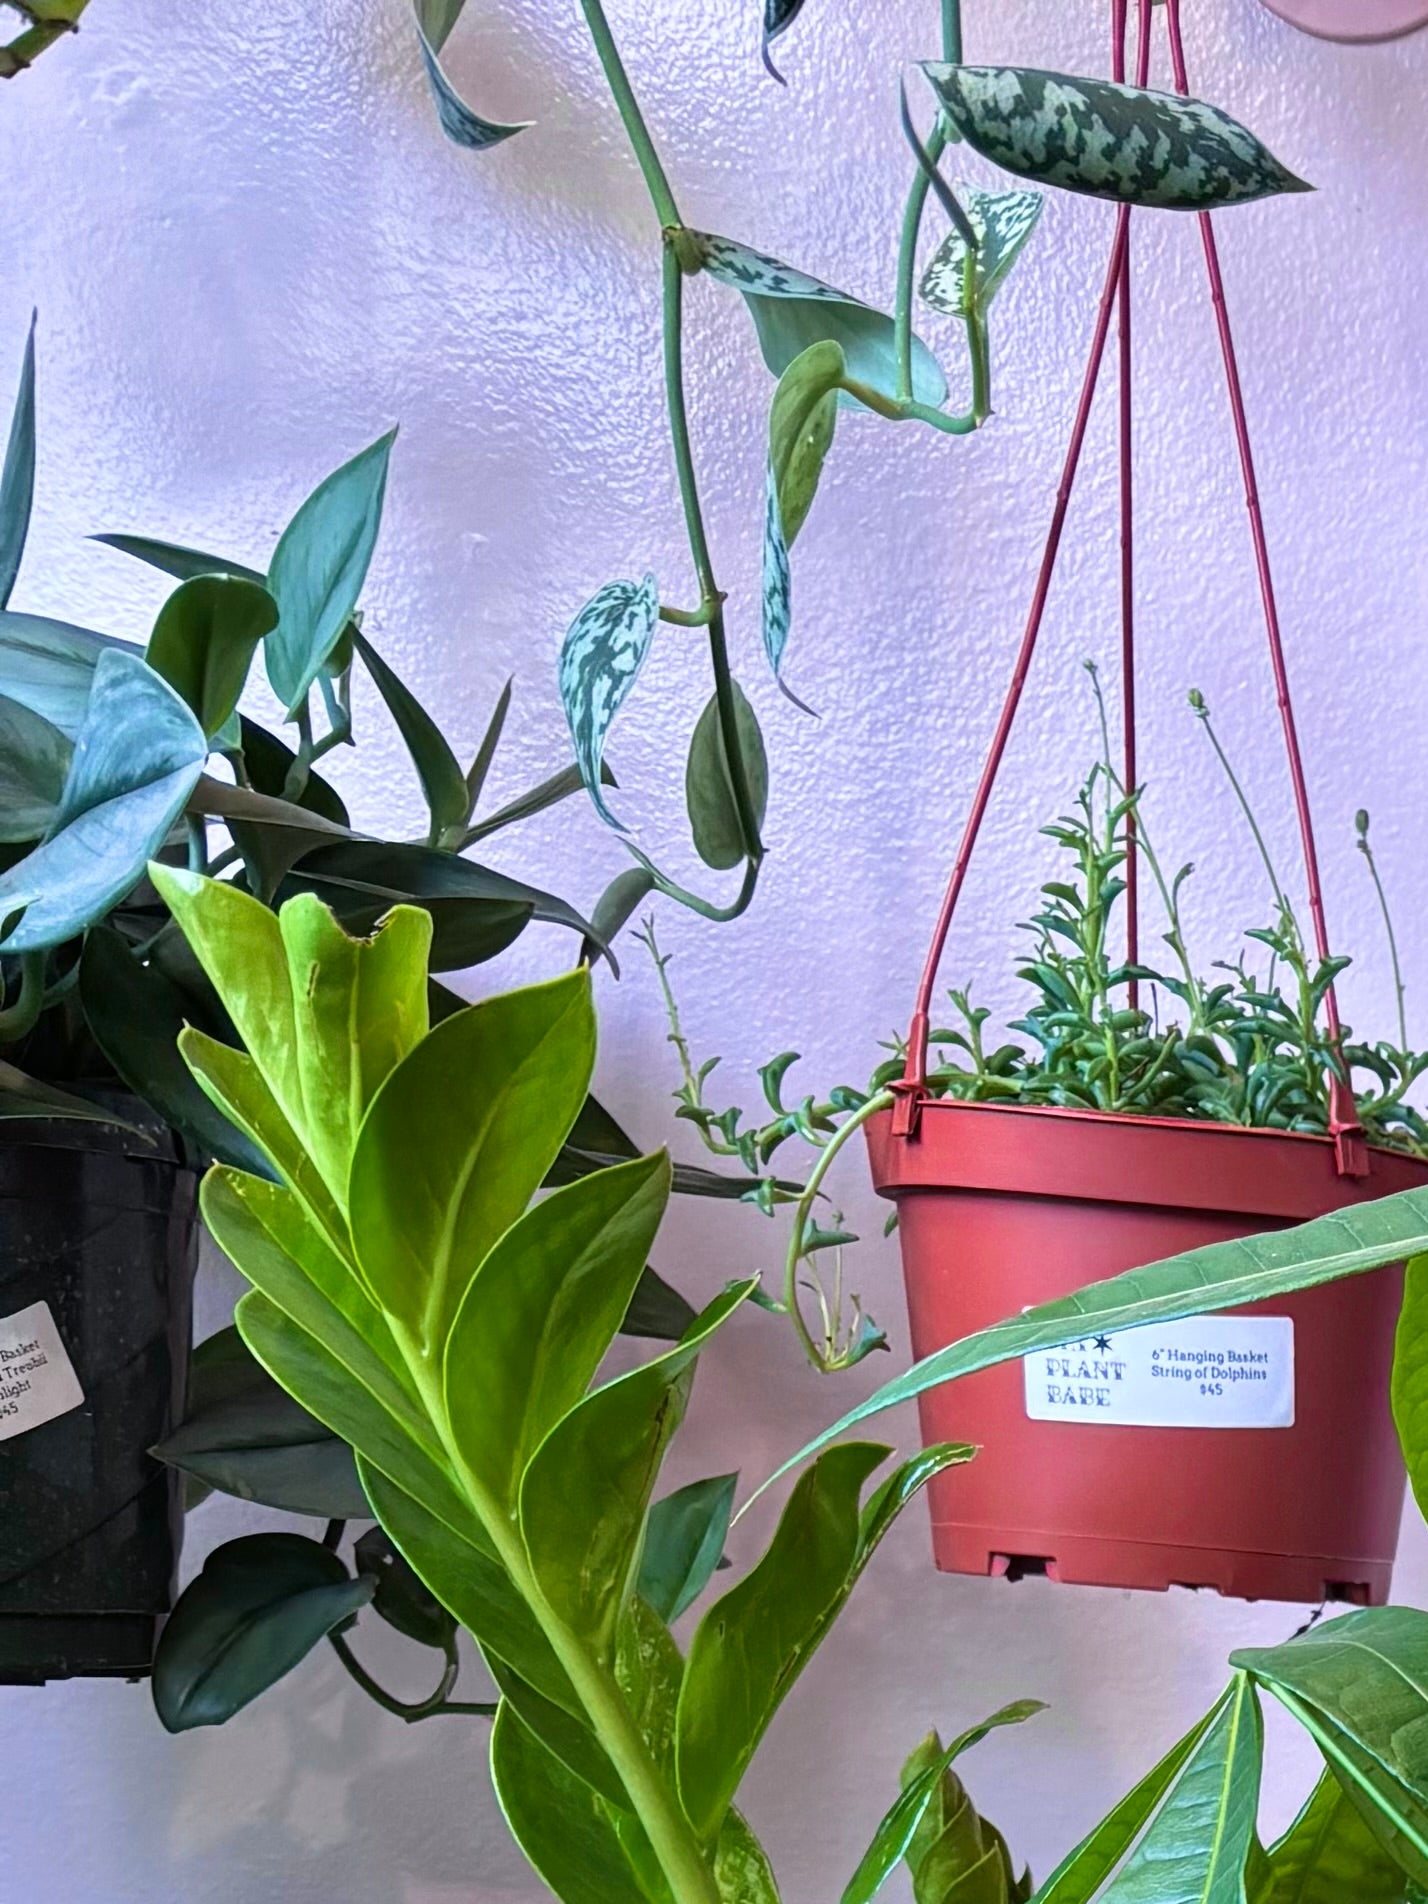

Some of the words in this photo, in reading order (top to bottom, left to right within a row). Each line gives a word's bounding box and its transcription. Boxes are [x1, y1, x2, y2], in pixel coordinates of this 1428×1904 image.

[1167, 1349, 1225, 1365] Hanging
[1227, 1349, 1268, 1364] Basket
[1046, 1358, 1126, 1381] PLANT
[1151, 1365, 1192, 1381] String
[1194, 1366, 1209, 1379] of
[1211, 1366, 1268, 1382] Dolphins
[1047, 1385, 1111, 1406] BABE
[1200, 1383, 1223, 1396] $45
